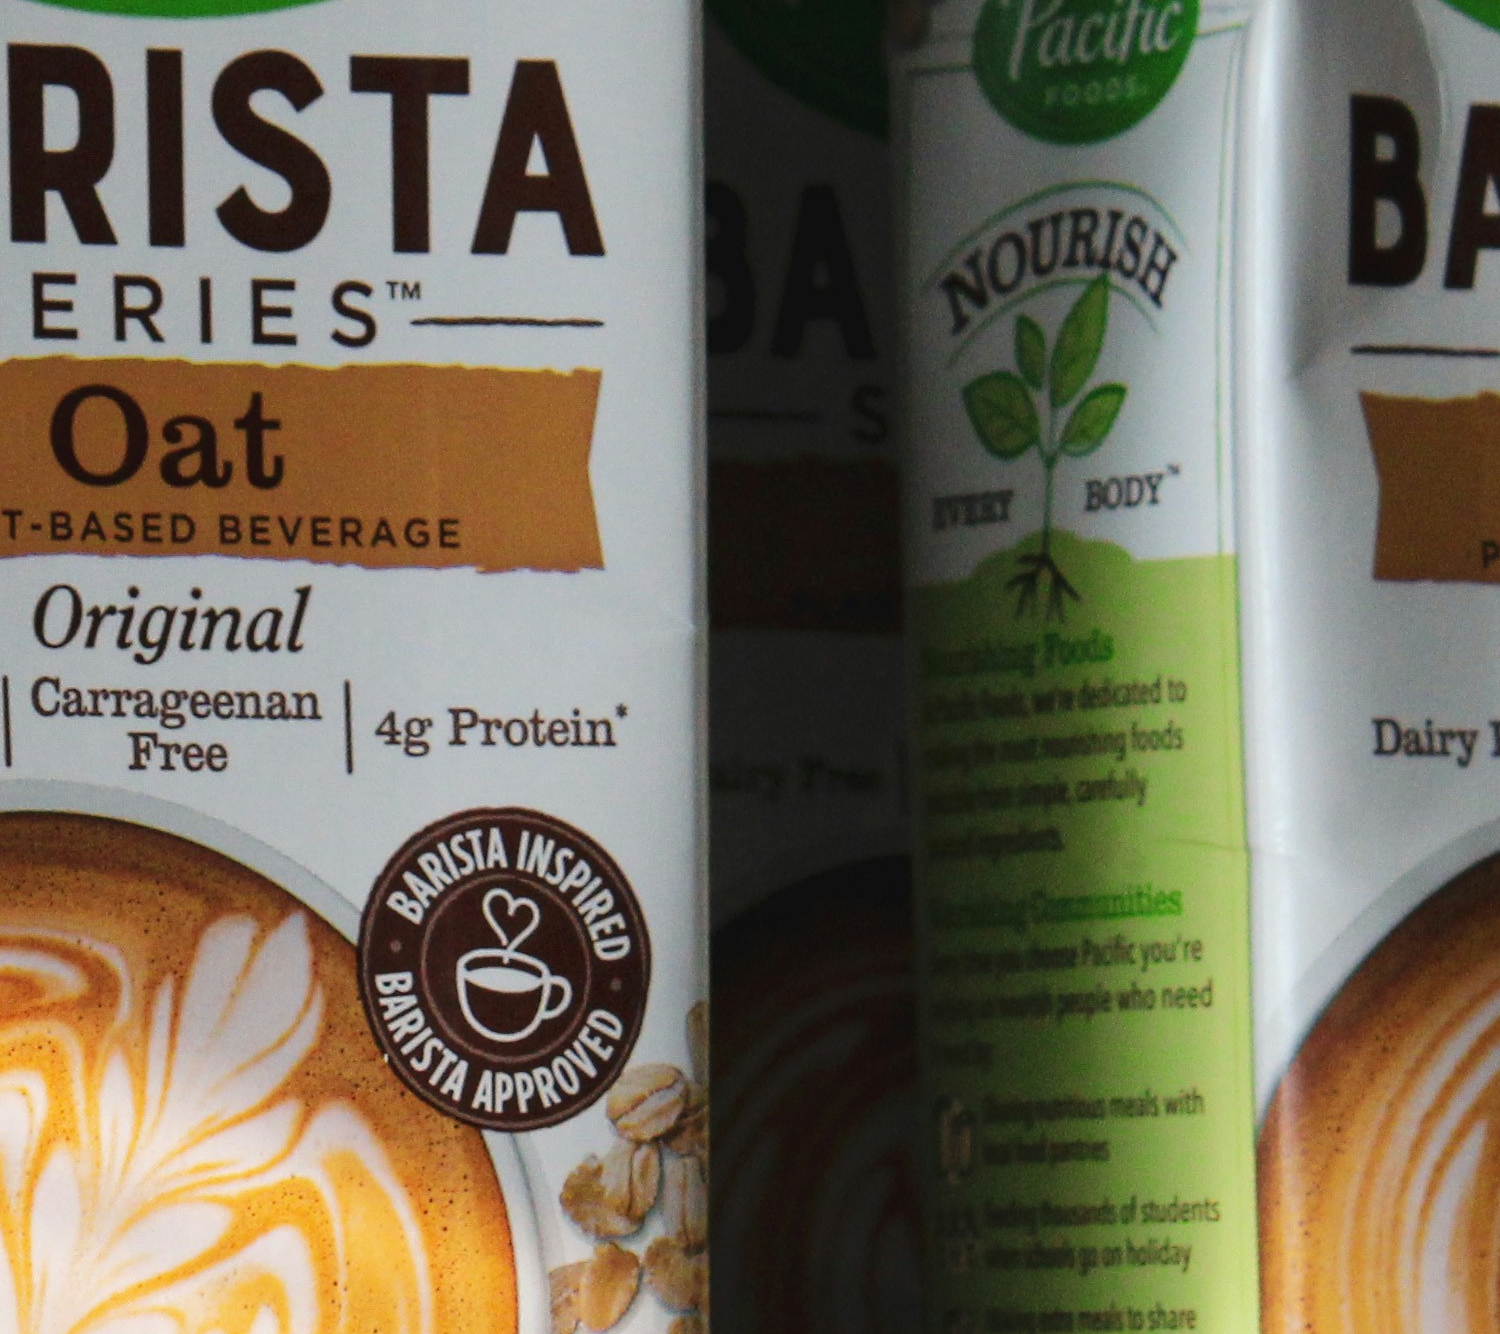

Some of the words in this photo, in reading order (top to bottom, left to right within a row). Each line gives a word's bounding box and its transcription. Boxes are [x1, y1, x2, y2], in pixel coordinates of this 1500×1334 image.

[940, 209, 1178, 335] NOURISH
[49, 384, 286, 490] Oat
[218, 512, 463, 551] BEVERAGE
[31, 583, 313, 665] Original
[29, 676, 321, 730] Carrageenan
[127, 730, 229, 774] Free
[373, 709, 433, 753] 4g
[1371, 717, 1483, 763] Dairy
[386, 827, 509, 925] BARISTA
[516, 829, 631, 962] INSPIRED
[1161, 978, 1214, 1009] need
[374, 971, 469, 1101] BARISTA
[471, 1008, 625, 1114] APPROVED
